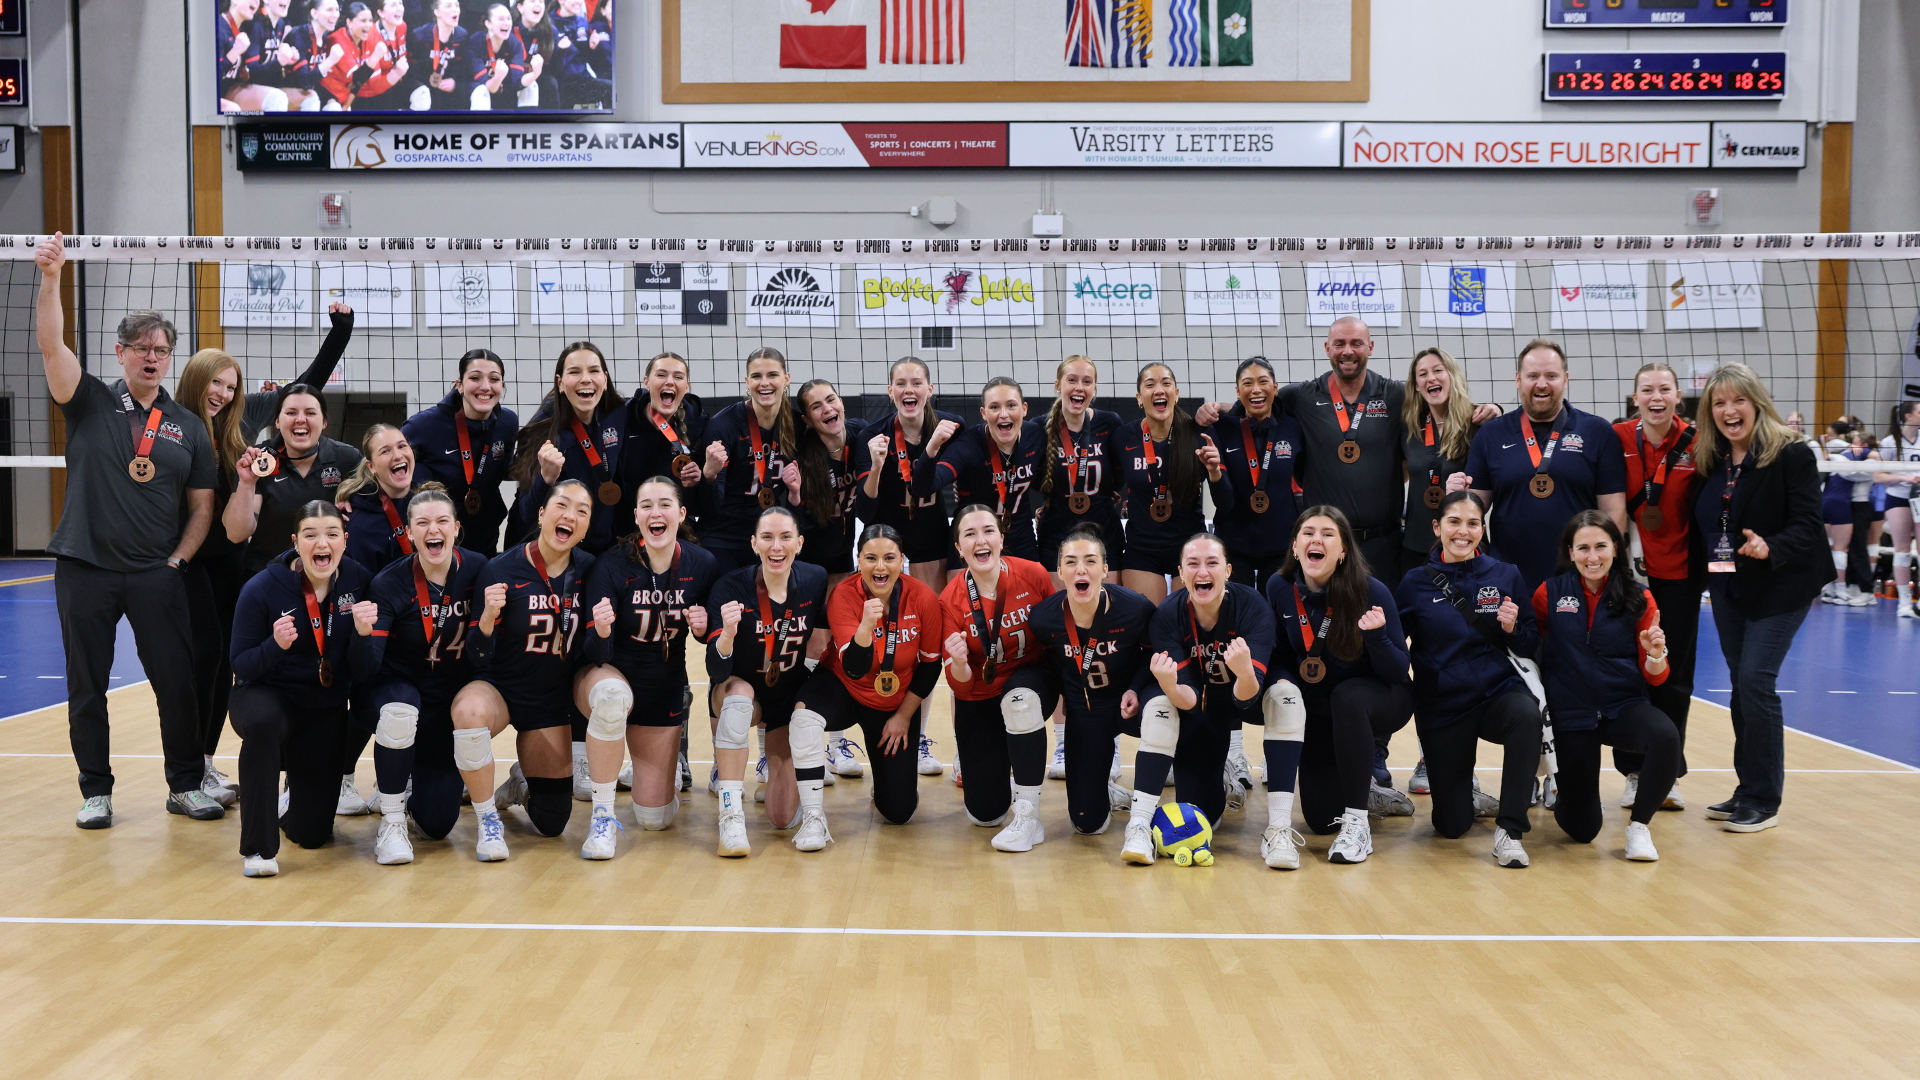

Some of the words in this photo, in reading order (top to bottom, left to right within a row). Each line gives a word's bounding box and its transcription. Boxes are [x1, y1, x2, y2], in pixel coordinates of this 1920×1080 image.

[1564, 13, 1586, 23] WON
[1651, 12, 1685, 23] MATCH
[1750, 12, 1773, 22] WON
[1575, 59, 1582, 69] 1
[1634, 58, 1641, 69] 2
[1692, 58, 1700, 69] 3
[1752, 58, 1759, 68] 4
[1558, 74, 1576, 88] 17
[1580, 72, 1604, 90] 25
[1611, 72, 1635, 90] 26
[1639, 72, 1664, 90] 24
[1670, 72, 1694, 90] 26
[1700, 72, 1723, 90] 24
[1735, 74, 1753, 90] 18
[1758, 72, 1782, 90] 25
[263, 133, 324, 141] WILLOUGHBY
[394, 134, 462, 150] HOME
[470, 134, 500, 150] OF
[506, 133, 552, 150] THE
[560, 132, 679, 150] SPARTANS
[1070, 127, 1165, 152] VARSITY
[1176, 134, 1274, 152] LETTERS
[265, 143, 323, 151] COMMUNITY
[1354, 141, 1464, 163] NORTON
[1476, 142, 1539, 162] ROSE
[1550, 142, 1700, 163] FULBRIGHT
[1742, 146, 1799, 156] CENTAUR
[394, 154, 483, 163] GOSPARTANS.CA
[506, 153, 592, 162] @TWUSPARTANS
[1196, 155, 1262, 163] VarsityLetters.ca
[645, 276, 670, 284] oddball
[864, 276, 943, 309] Booster
[971, 275, 1034, 305] Juice
[1077, 274, 1152, 300] Acera
[1317, 283, 1376, 296] KPMG
[1585, 292, 1638, 300] TRAVELLER
[1320, 301, 1349, 310] Private
[1352, 301, 1394, 313] Enterprise
[1452, 302, 1483, 313] RBC
[1058, 443, 1102, 459] BOCK
[756, 615, 807, 634] BOCK
[1088, 660, 1110, 689] 8
[1204, 659, 1231, 684] 9
